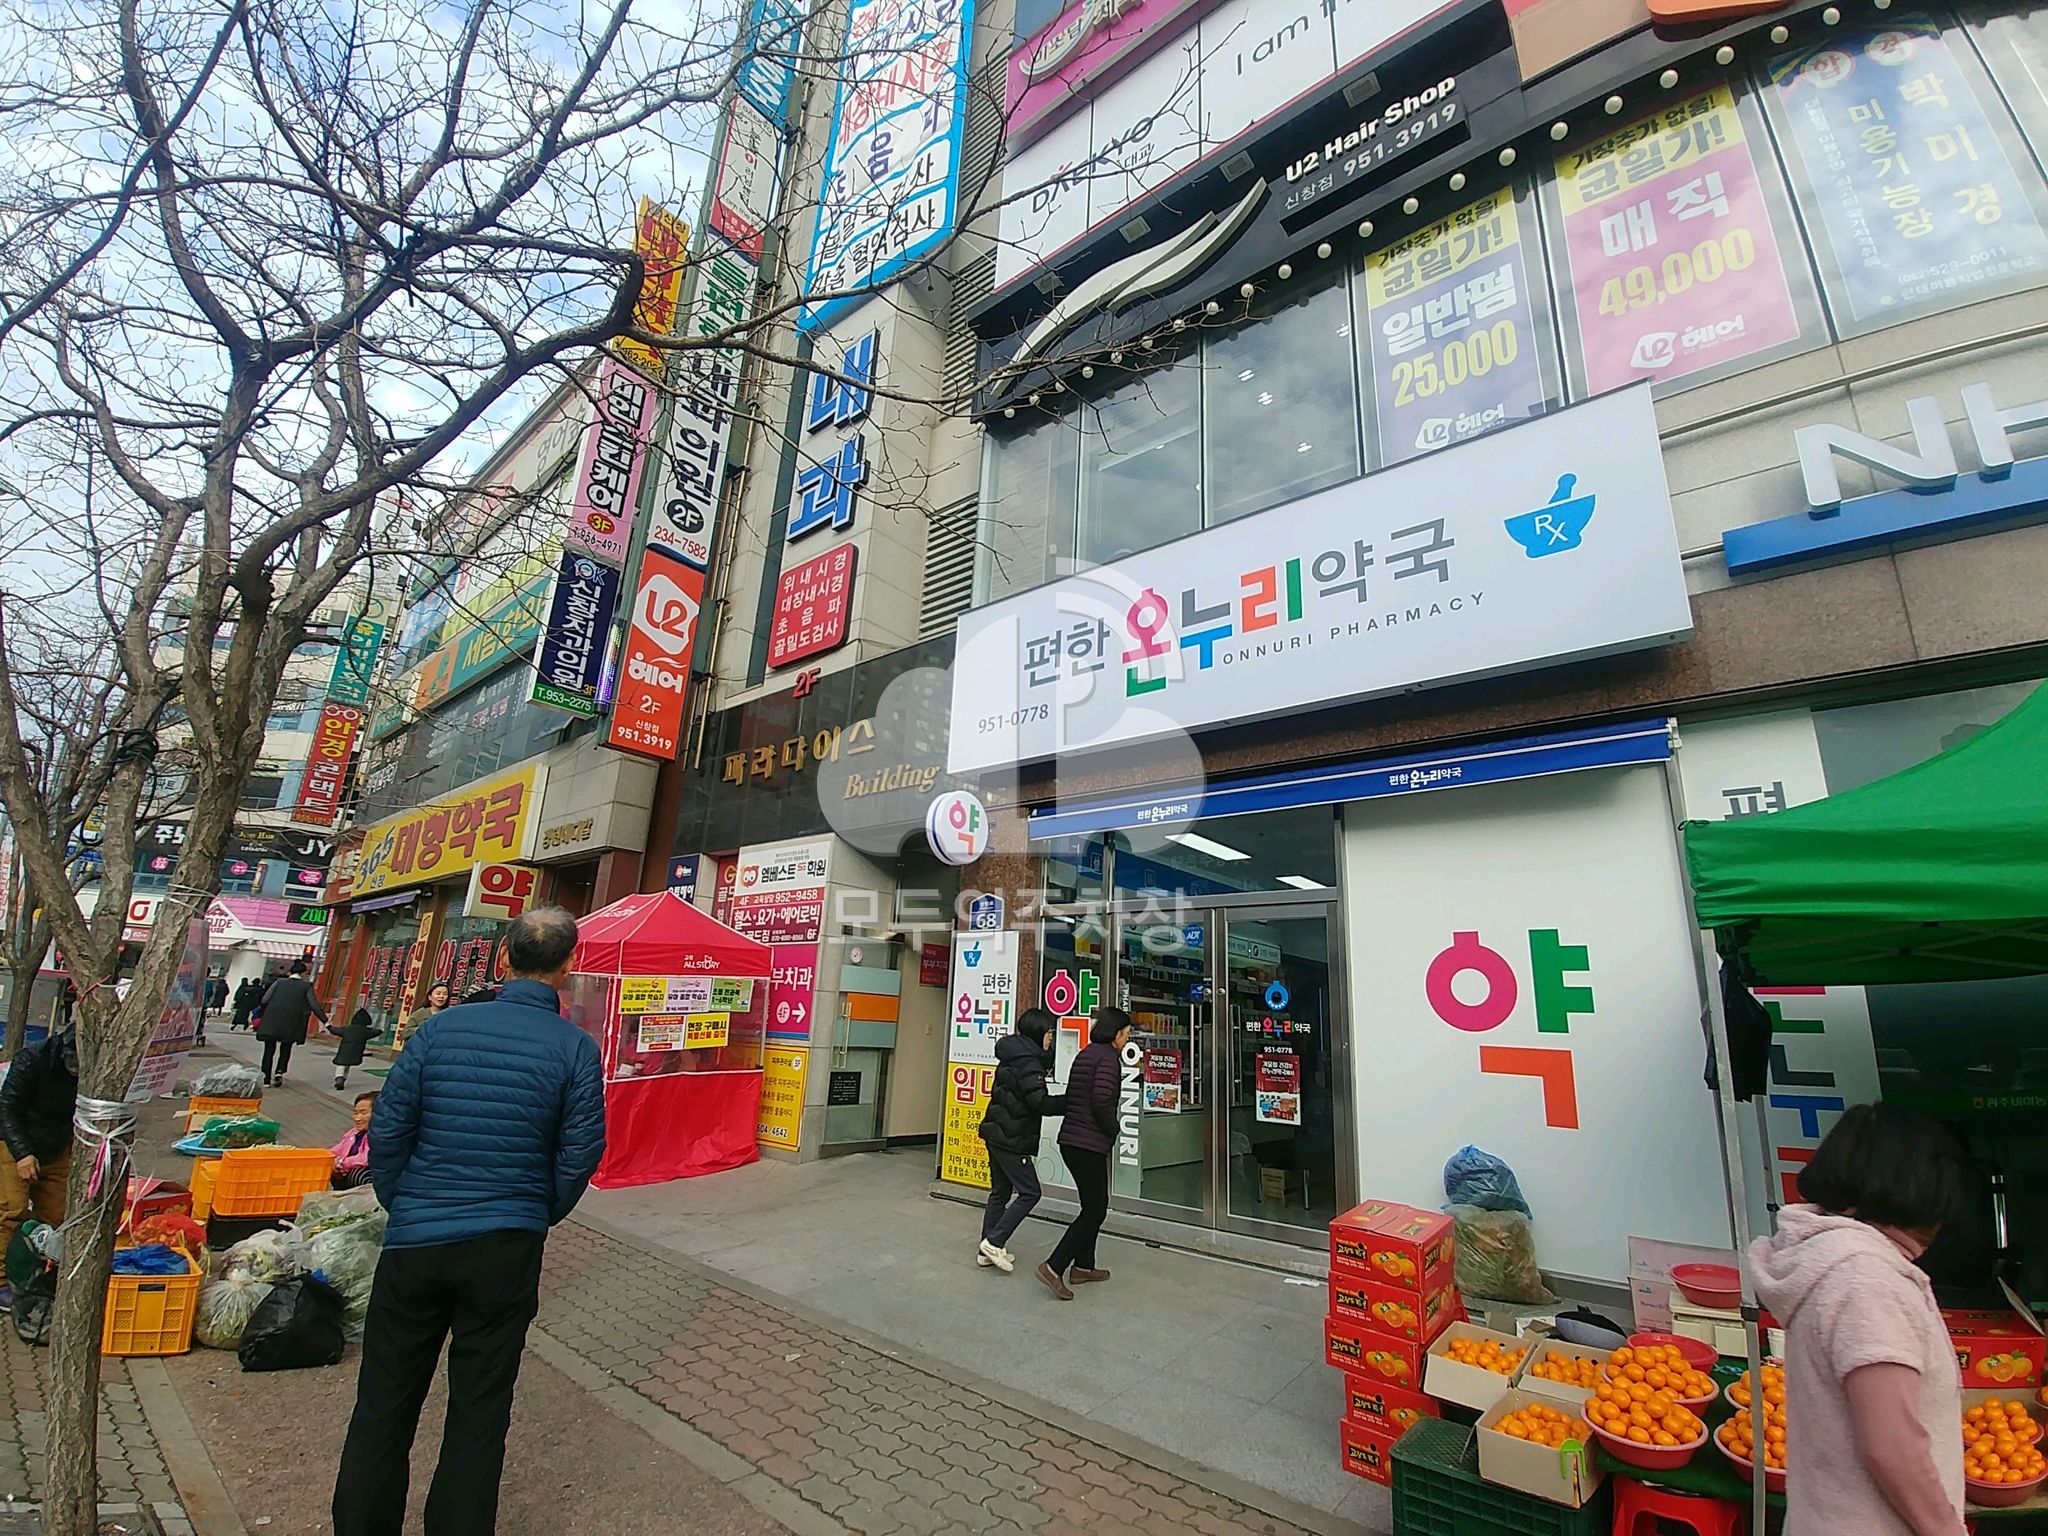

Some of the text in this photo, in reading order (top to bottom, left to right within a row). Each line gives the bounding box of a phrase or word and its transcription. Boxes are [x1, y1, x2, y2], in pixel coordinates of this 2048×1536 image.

[1252, 15, 1309, 63] am
[1285, 76, 1456, 184] U2 Hair Shop
[1285, 102, 1457, 210] 신창점 951.3919
[1579, 115, 1724, 203] 균일가!
[1847, 98, 1934, 239] 미용기능장
[1383, 216, 1504, 298] 균일가!
[1599, 228, 1756, 318] 49,000
[1382, 262, 1518, 356] 일반펌
[1681, 313, 1745, 348] 헤어
[1391, 319, 1519, 408] 25,000
[788, 330, 881, 541] 내과
[1456, 402, 1506, 433] 헤어
[589, 516, 613, 532] 3F
[672, 502, 701, 530] 2F
[653, 524, 708, 561] 234-7582
[783, 550, 848, 593] 위내시경
[780, 573, 844, 614] 대장내시경
[1024, 517, 1455, 698] 편한 온누리약국
[551, 579, 603, 693] 신창치과의원
[776, 598, 842, 636] 초음파
[1223, 591, 1485, 666] ONNURI PHARMACY
[773, 620, 839, 658] 골밀도검사
[628, 656, 684, 694] 헤어
[792, 666, 822, 698] 2F
[537, 686, 593, 712] T.953-2275
[639, 694, 662, 715] 2F
[616, 725, 673, 751] 951.3919
[634, 719, 661, 735] 신창점
[978, 703, 1050, 735] 951-0778
[723, 718, 876, 786] 파라다이스
[842, 764, 941, 800] Building
[1389, 766, 1463, 790] 편한 온누리약국
[948, 799, 981, 856] 약
[1137, 803, 1188, 823] 편한 온누리약국
[297, 838, 334, 858] JY
[356, 825, 397, 890] 365
[391, 781, 525, 876] 대형약국
[480, 864, 539, 919] 약
[738, 896, 750, 906] 4F
[775, 889, 819, 904] 952-9458
[300, 907, 329, 924] 200
[975, 912, 998, 930] 68
[1186, 930, 1200, 941] ADT
[982, 972, 1012, 996] 편한
[954, 992, 1011, 1039] 온누리
[1045, 968, 1101, 1053] 약
[1246, 1016, 1311, 1039] 편한 온누리약국
[1426, 928, 1596, 1130] 약
[1264, 1046, 1293, 1054] 951-0778
[967, 1108, 982, 1120] 35평
[1118, 1040, 1143, 1168] ONNURI
[948, 1154, 962, 1166] 지하
